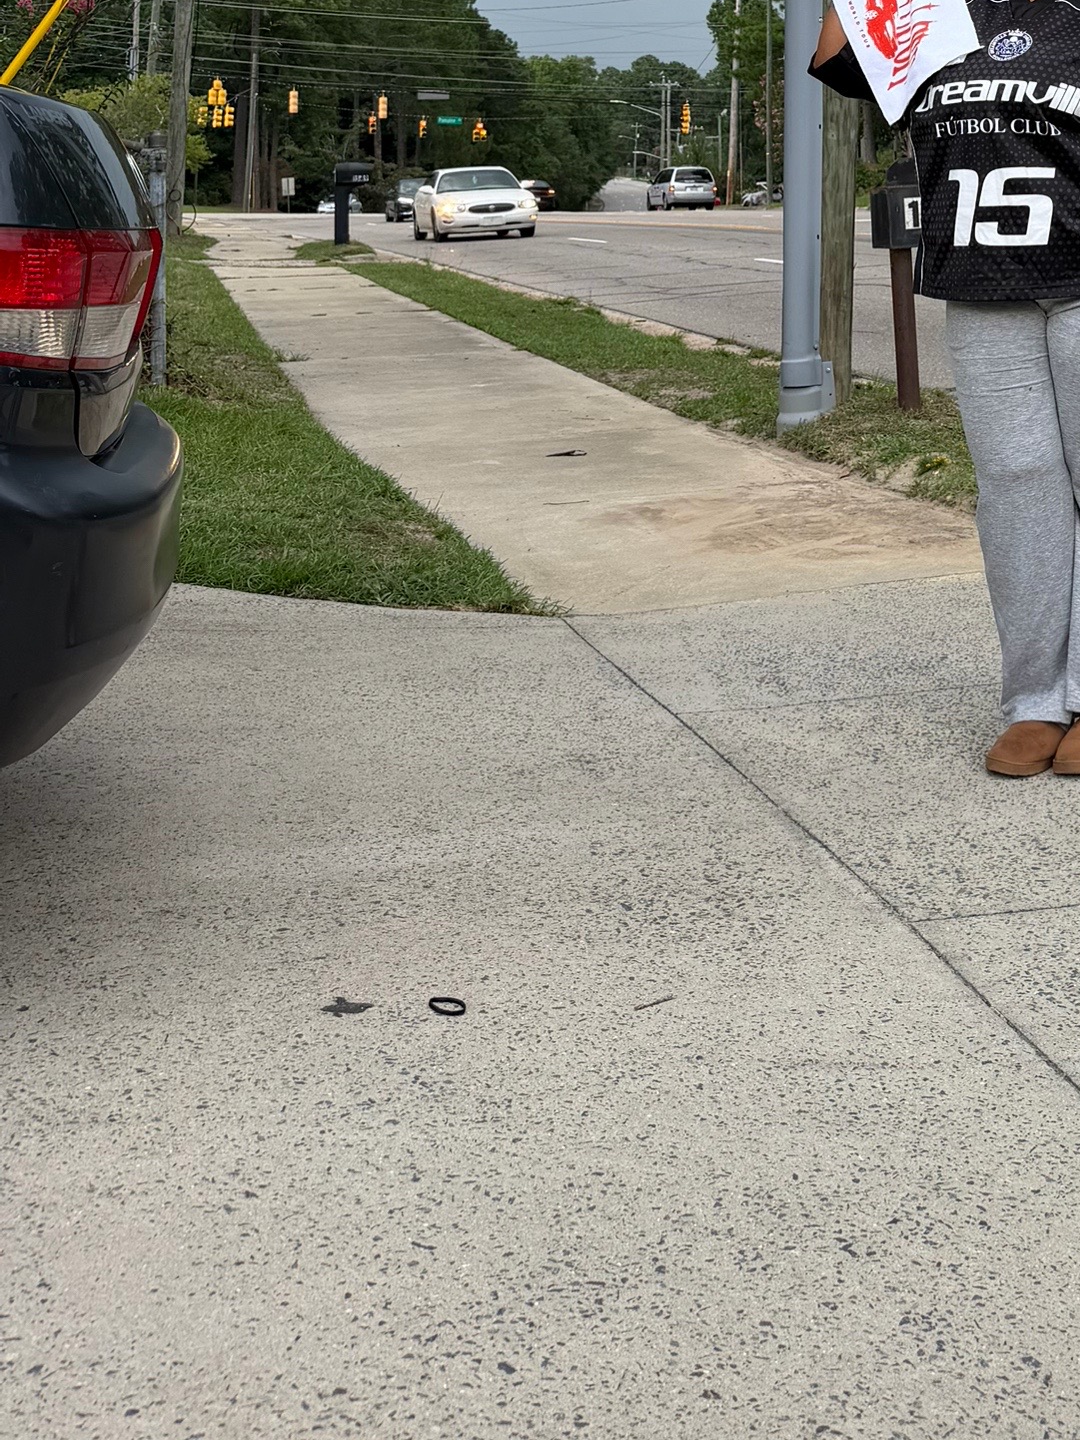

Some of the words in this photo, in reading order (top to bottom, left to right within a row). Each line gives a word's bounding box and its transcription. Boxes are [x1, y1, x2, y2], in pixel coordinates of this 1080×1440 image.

[848, 0, 861, 26] WORLD
[859, 28, 871, 48] TOUR
[935, 116, 1006, 138] FÚTBOL
[908, 200, 920, 228] 1
[948, 166, 1056, 247] 15
